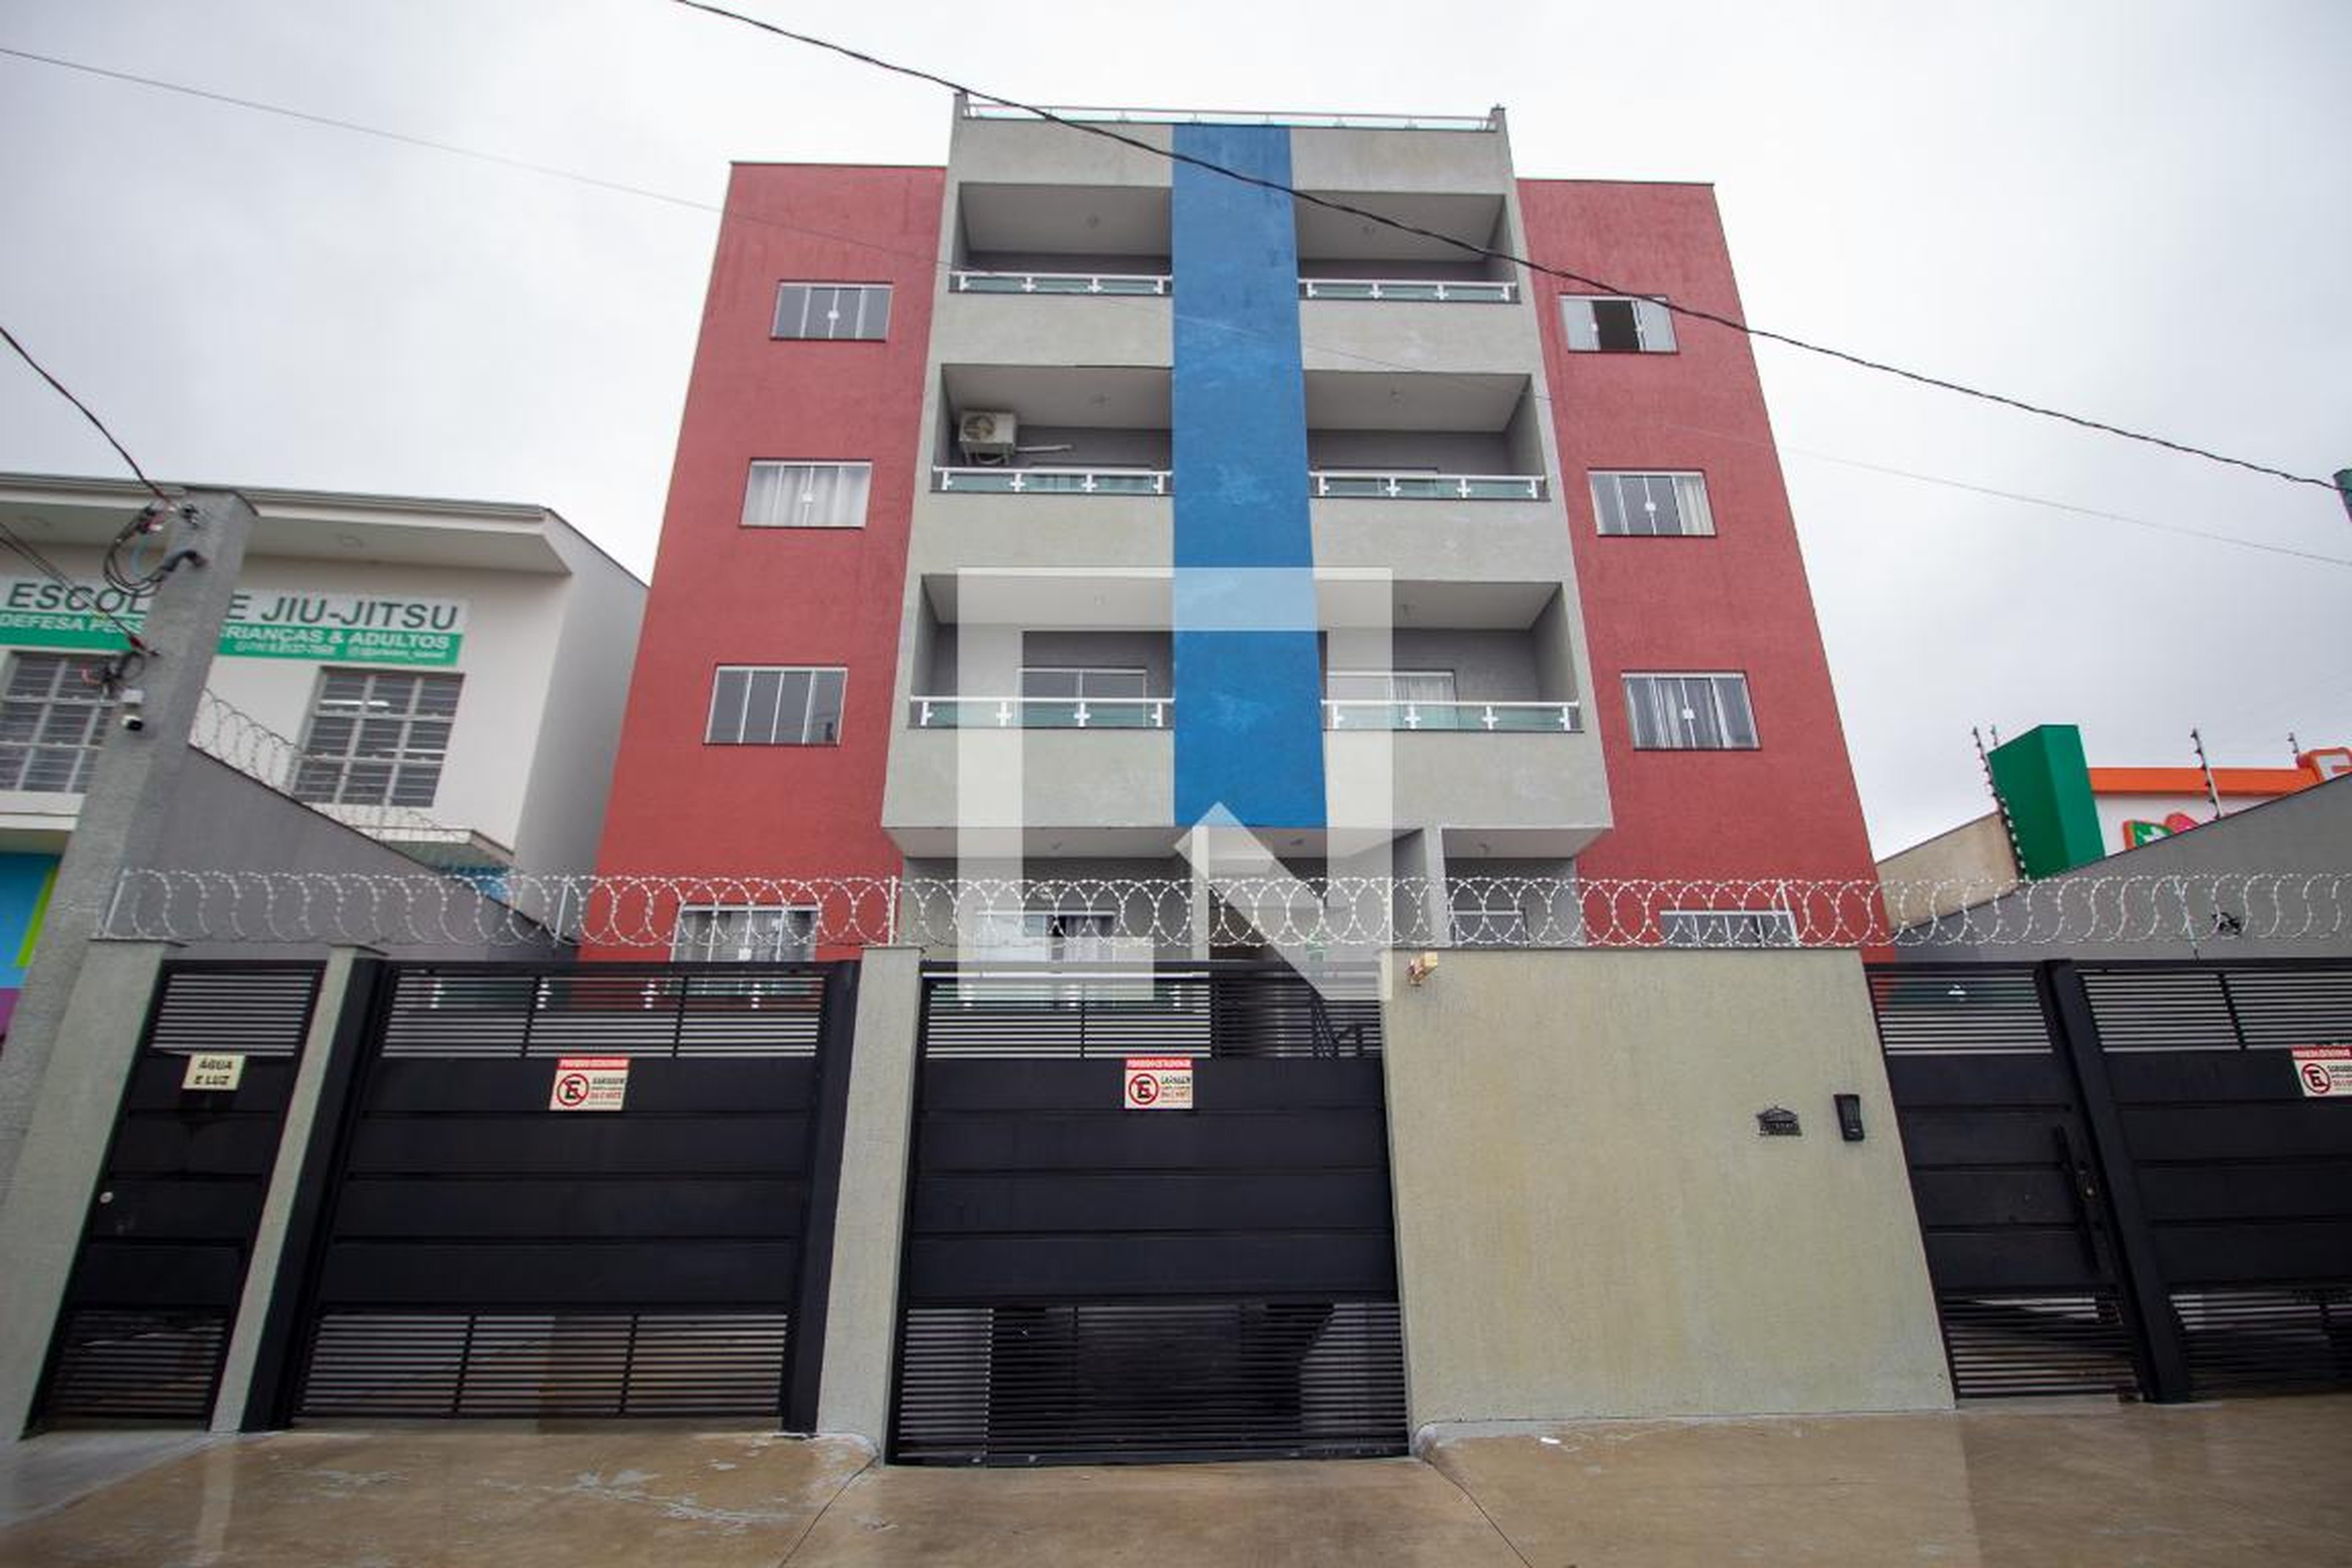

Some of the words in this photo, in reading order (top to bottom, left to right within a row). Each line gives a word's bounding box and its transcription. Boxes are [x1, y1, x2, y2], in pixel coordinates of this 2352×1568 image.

[7, 583, 147, 614] ESCOL
[228, 595, 251, 620] E
[261, 597, 458, 630] JIU-JITSU
[328, 631, 344, 644] &
[349, 631, 450, 650] ADULTOS
[205, 1075, 230, 1085] LUZ
